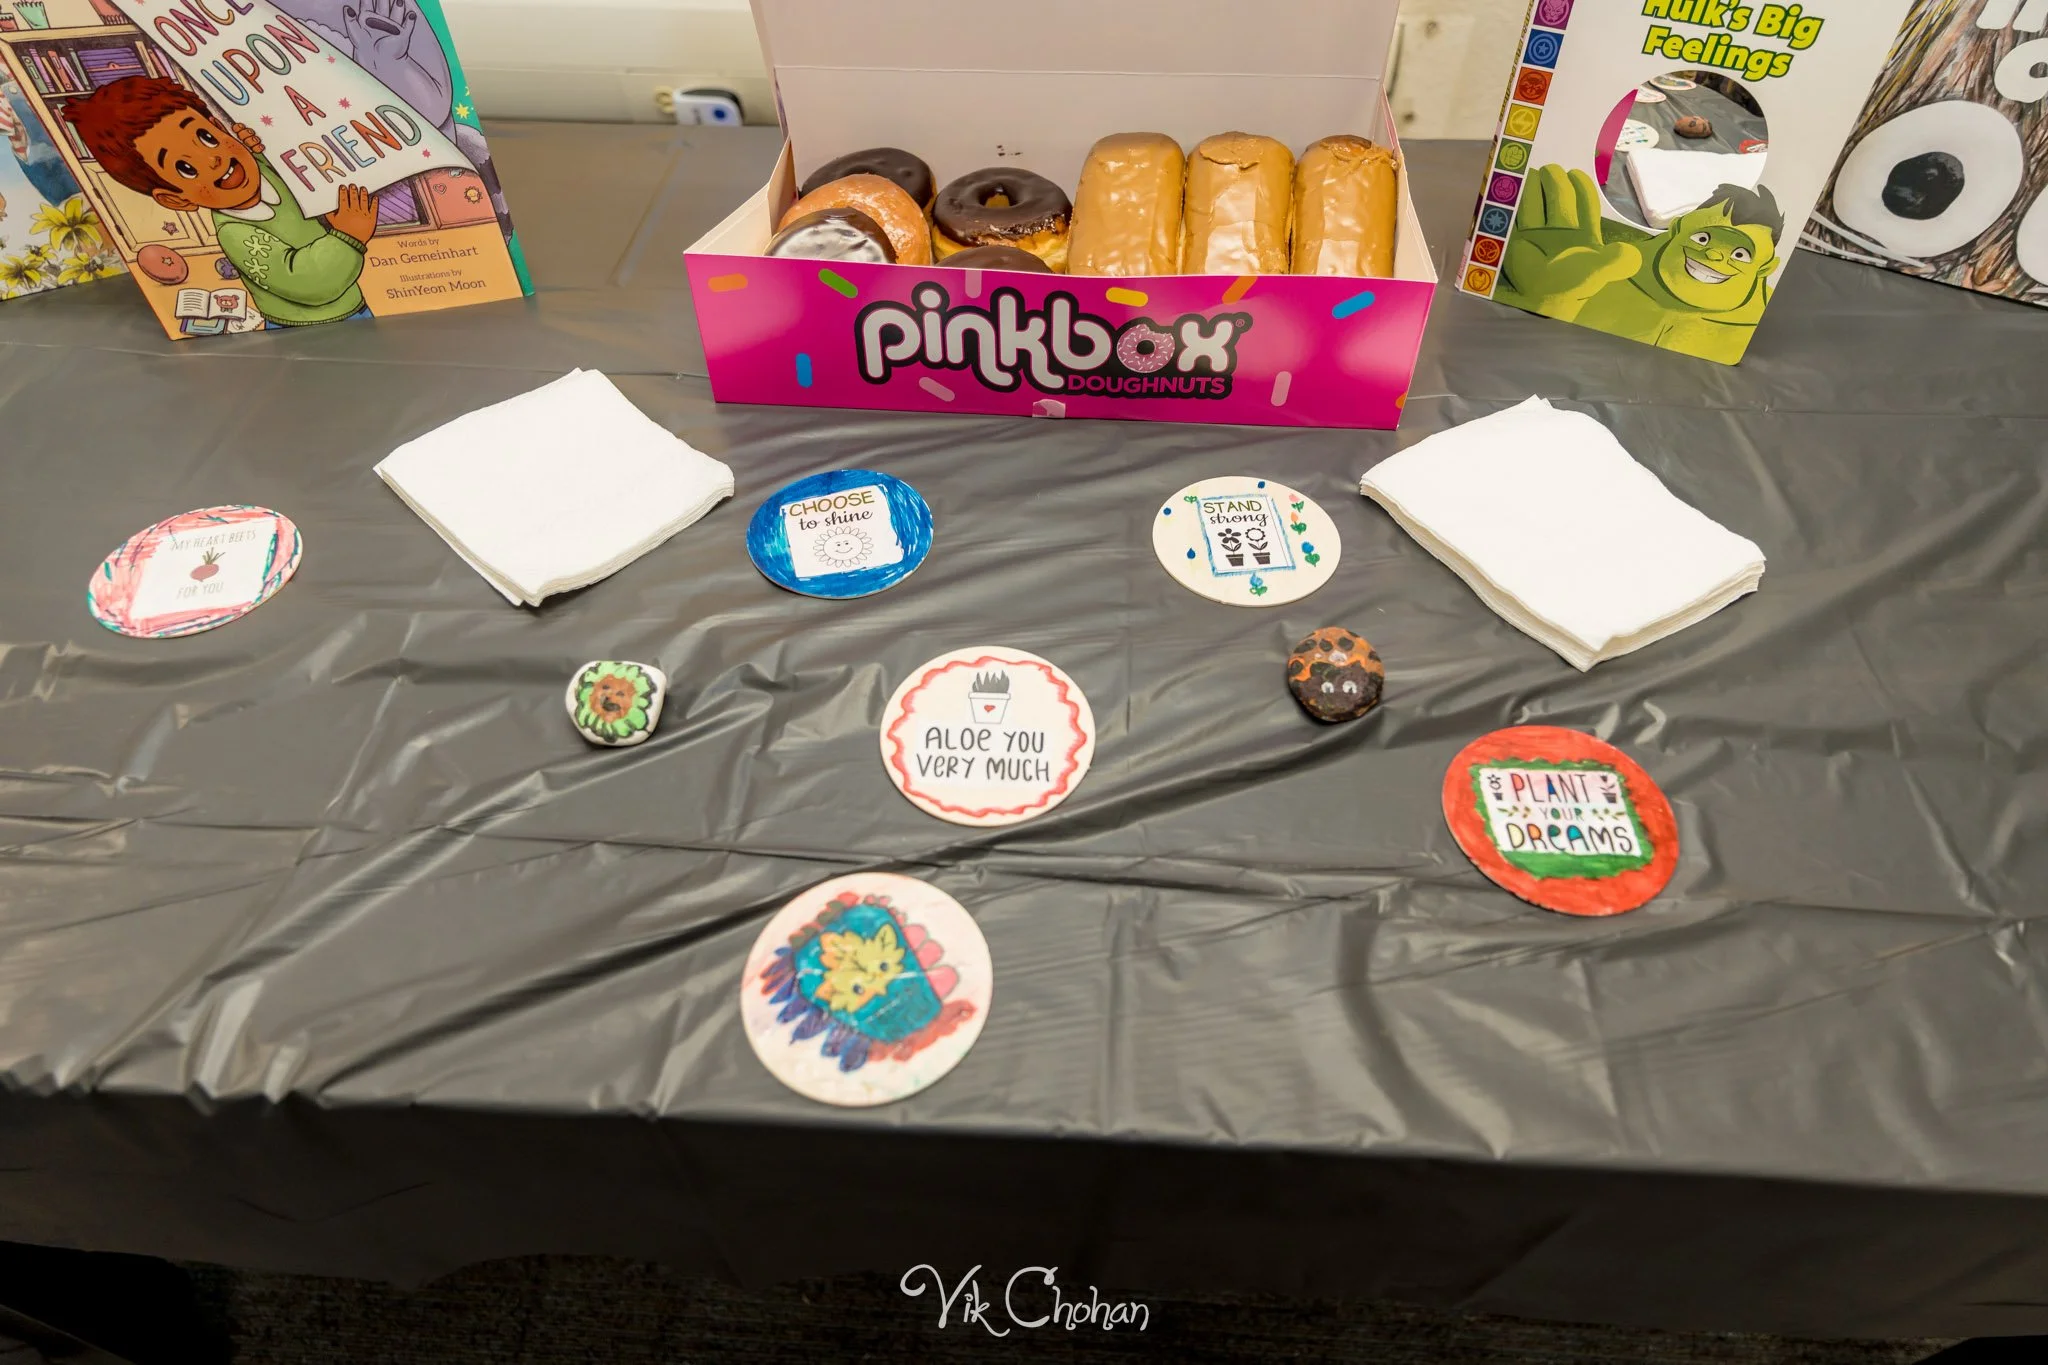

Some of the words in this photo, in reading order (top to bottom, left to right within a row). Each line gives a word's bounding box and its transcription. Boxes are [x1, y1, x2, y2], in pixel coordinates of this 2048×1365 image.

[1753, 3, 1825, 50] Big
[200, 14, 320, 106] UPON
[1641, 24, 1795, 82] Feelings
[283, 85, 326, 126] A
[279, 104, 422, 192] FRIEND
[397, 238, 427, 249] Words
[429, 237, 440, 246] by
[369, 256, 398, 268] Dan
[400, 246, 479, 264] Gemeinhart
[399, 270, 450, 282] Illustrations
[451, 268, 462, 277] by
[386, 284, 447, 299] ShinYeon
[450, 279, 487, 292] Moon
[859, 285, 1237, 390] pinkbox
[1067, 374, 1226, 395] DOUGHNUTS
[789, 490, 875, 517] CHOOSE
[1203, 500, 1263, 514] STAND
[799, 517, 820, 531] to
[824, 510, 874, 527] shine
[1209, 513, 1269, 527] strong
[170, 540, 192, 552] MY
[193, 535, 226, 549] HEART
[176, 584, 199, 600] FOR
[202, 581, 225, 596] YOU
[1003, 731, 1045, 754] YOU
[986, 757, 1050, 783] MUCH
[1510, 772, 1591, 804] PLANT
[1539, 807, 1585, 822] YOUR
